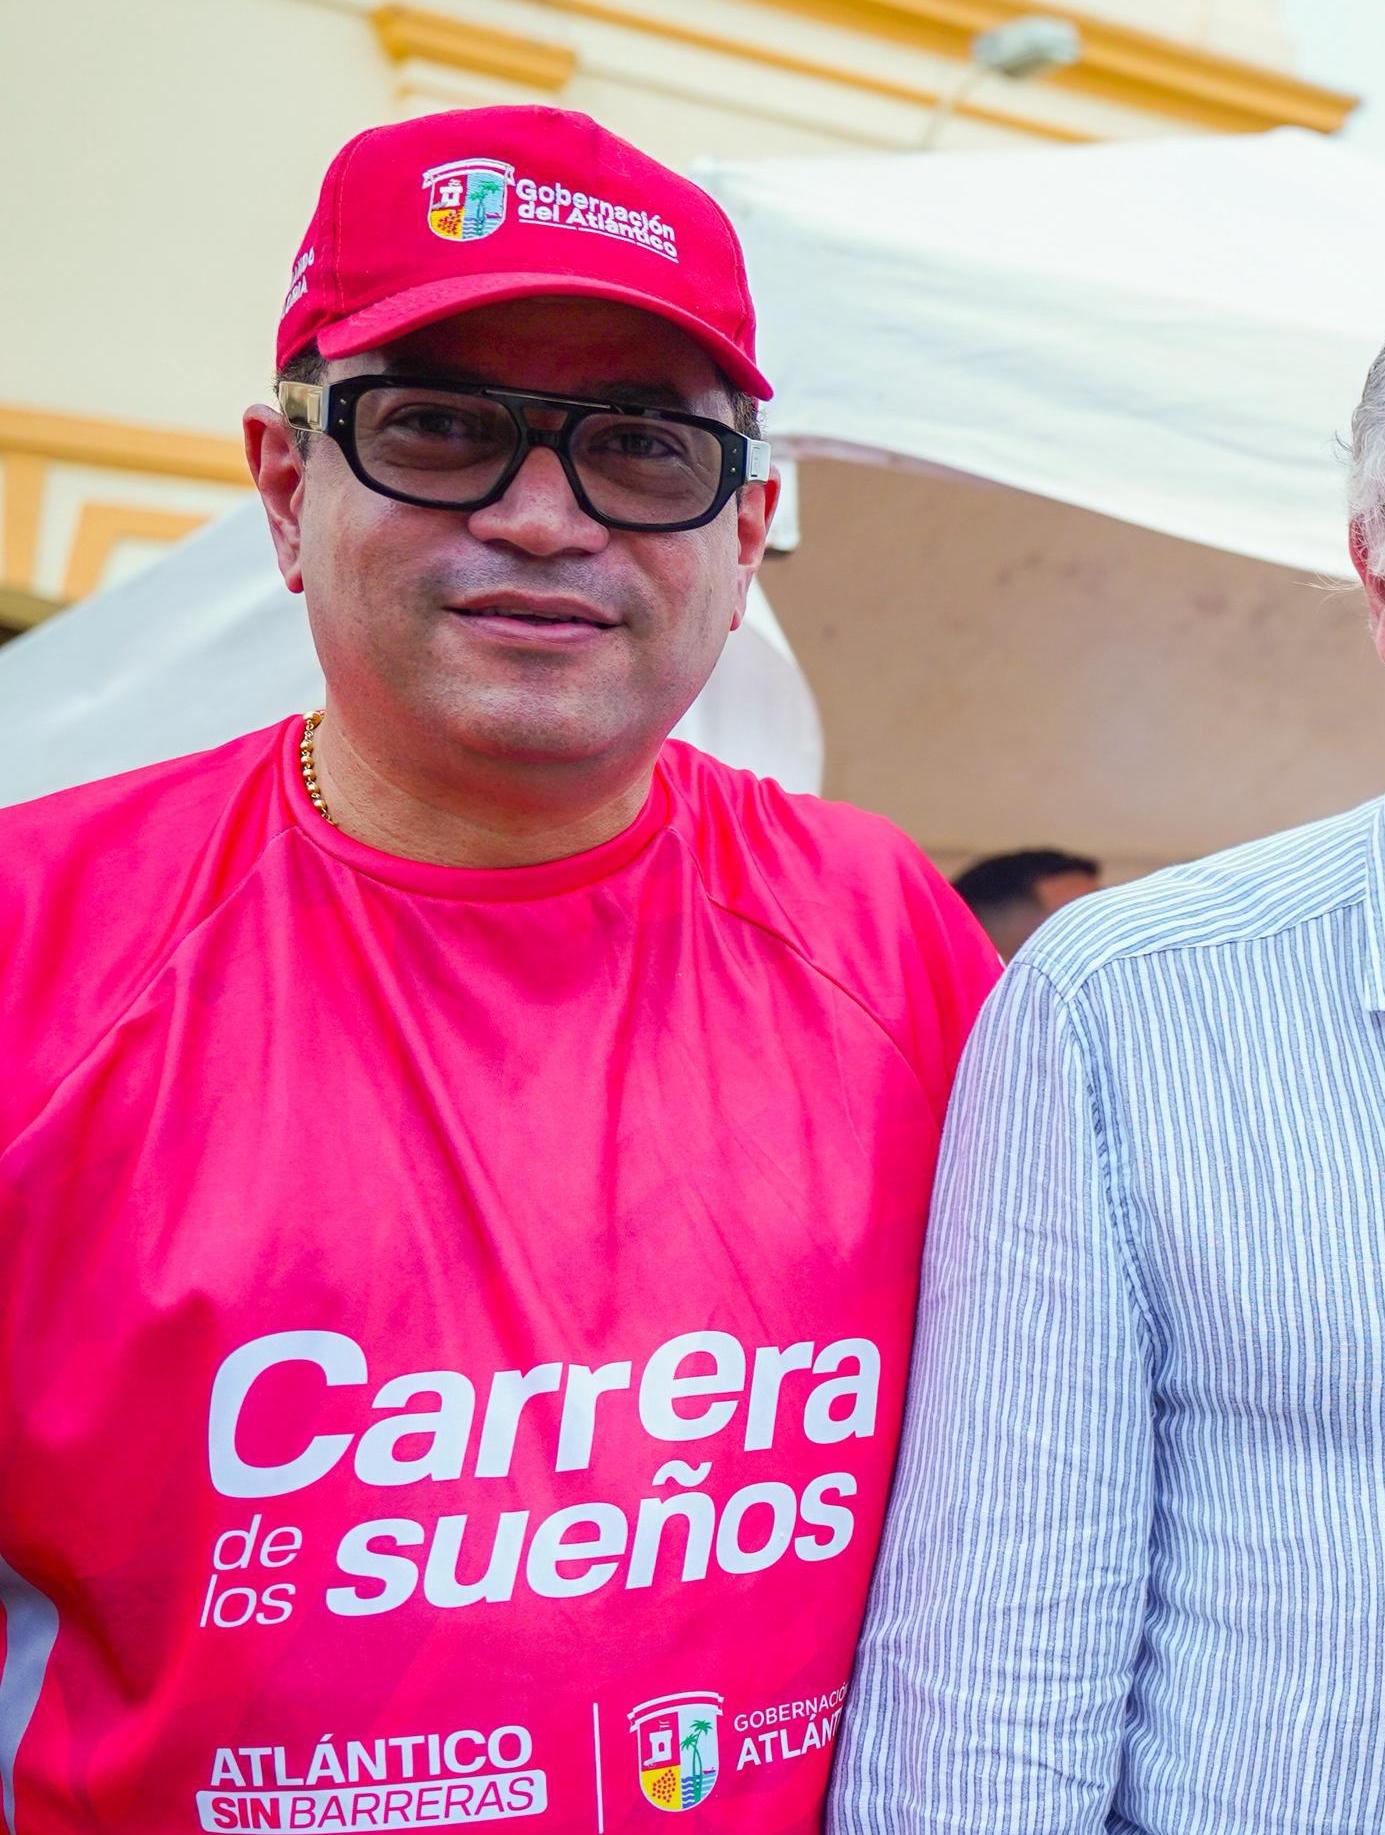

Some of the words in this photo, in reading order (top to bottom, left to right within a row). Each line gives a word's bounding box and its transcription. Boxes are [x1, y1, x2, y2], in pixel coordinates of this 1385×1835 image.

[515, 178, 676, 242] Gobernación
[518, 201, 560, 222] del
[566, 206, 678, 258] Atlántico
[207, 1330, 881, 1499] Carrera
[200, 1574, 295, 1628] los
[326, 1460, 858, 1617] sueños
[212, 1514, 302, 1571] de
[210, 1724, 533, 1787] ATLÁNTICO
[213, 1796, 282, 1830] SIN
[288, 1776, 536, 1830] BARRERAS
